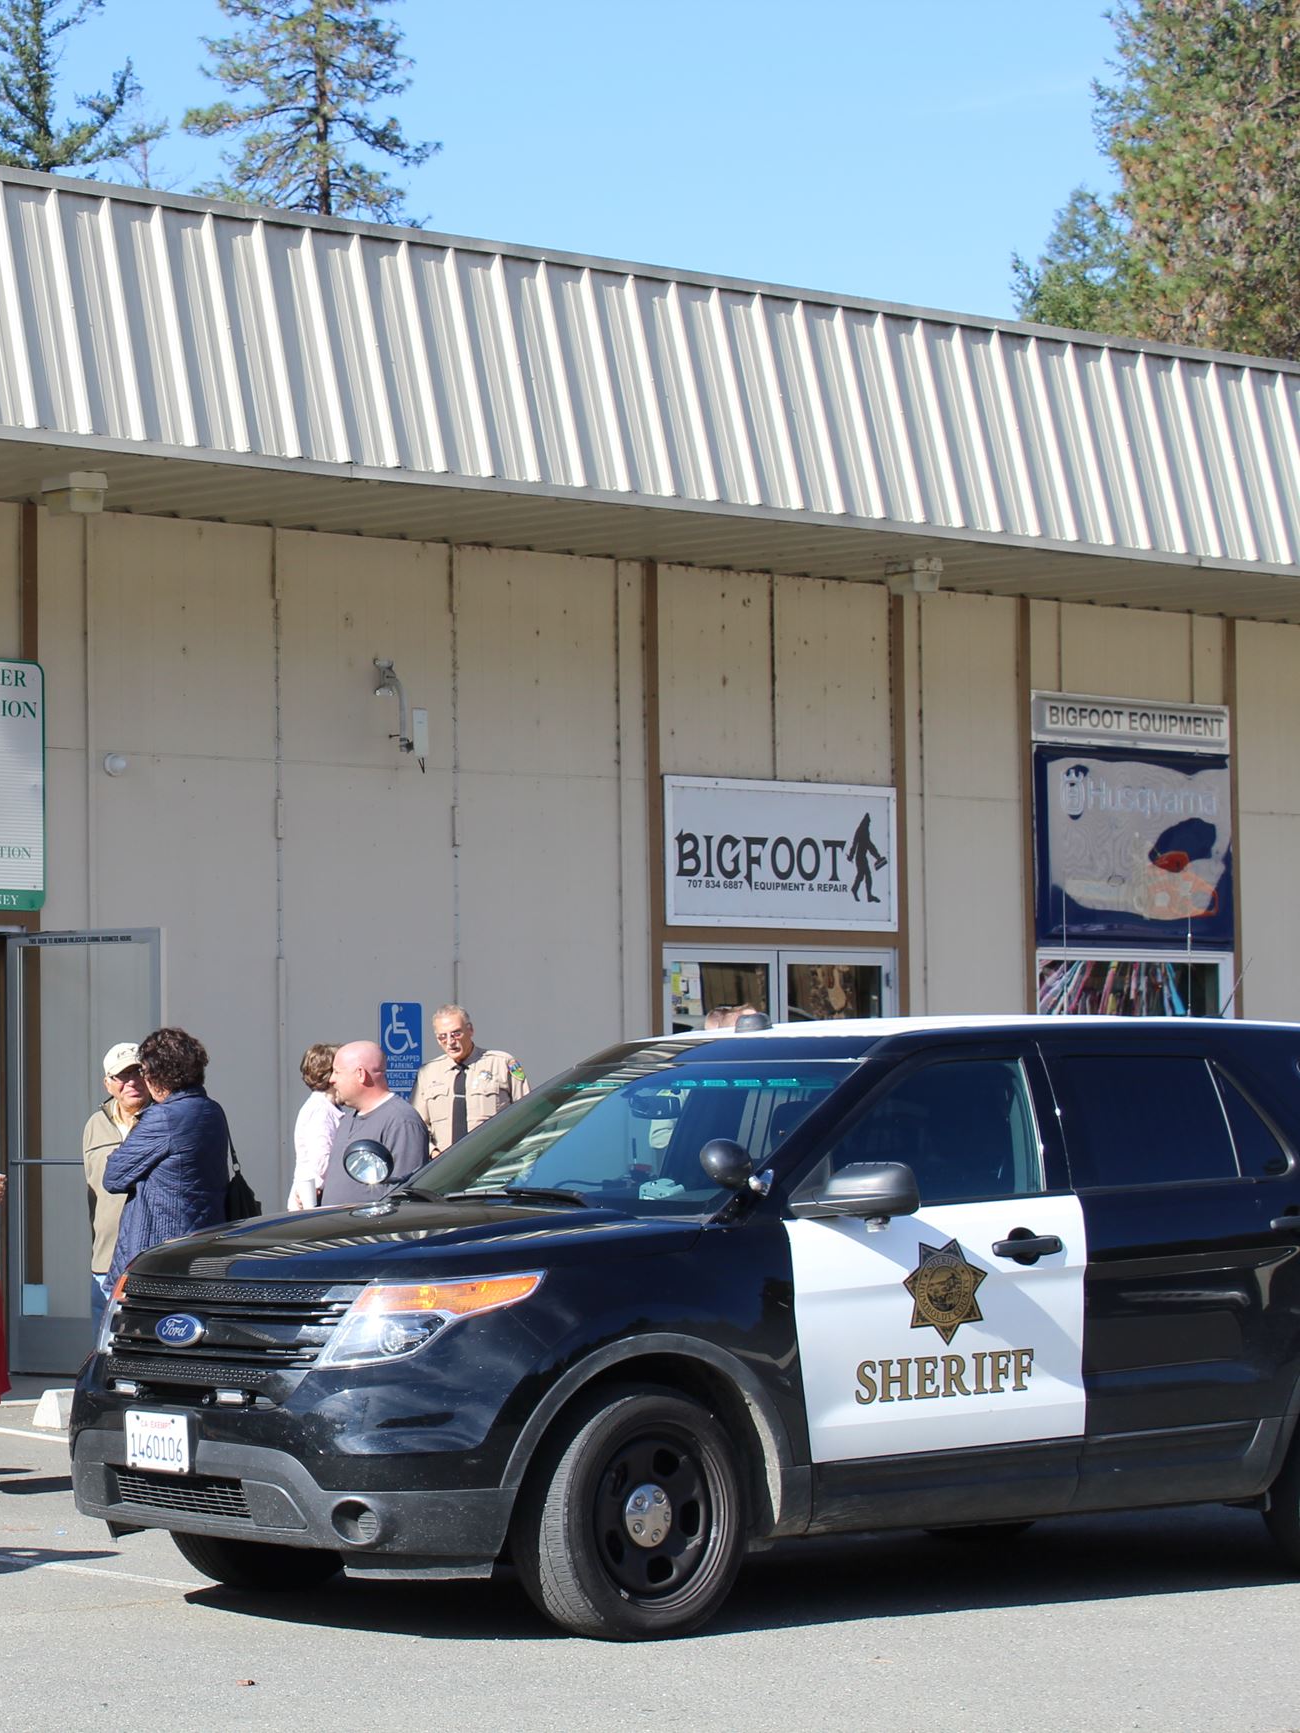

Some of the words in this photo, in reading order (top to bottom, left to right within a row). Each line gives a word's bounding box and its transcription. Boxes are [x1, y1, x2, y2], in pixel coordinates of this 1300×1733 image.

[1049, 704, 1124, 731] BIGFOOT
[1128, 711, 1224, 738] EQUIPMENT
[1087, 778, 1218, 816] Husqvarna
[674, 828, 847, 891] BIGFOOT
[687, 879, 703, 889] 707
[705, 879, 721, 889] 834
[723, 880, 744, 890] 6887
[753, 881, 806, 892] EQUIPMENT
[808, 882, 815, 892] &
[816, 883, 848, 893] REPAIR
[162, 1318, 188, 1337] Ford
[855, 1349, 1034, 1405] SHERIFF
[131, 1432, 183, 1463] 1460106
